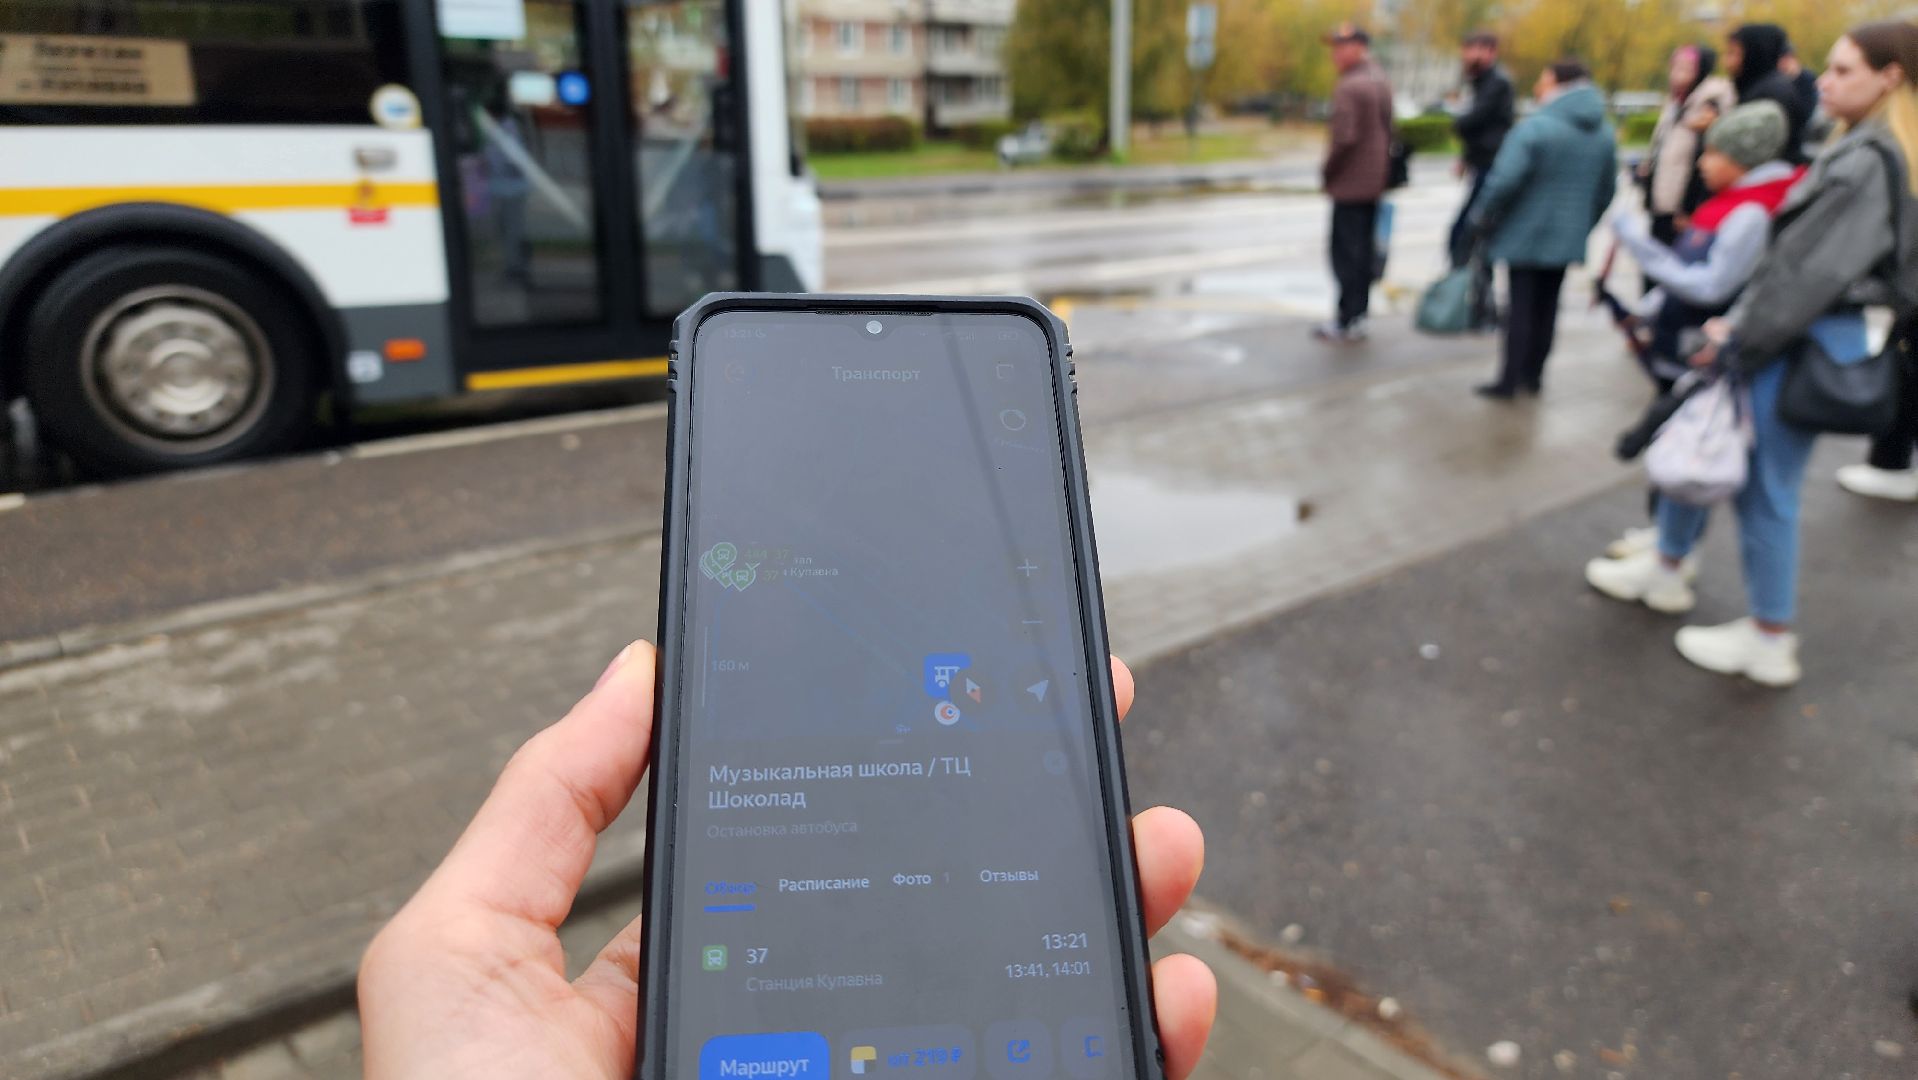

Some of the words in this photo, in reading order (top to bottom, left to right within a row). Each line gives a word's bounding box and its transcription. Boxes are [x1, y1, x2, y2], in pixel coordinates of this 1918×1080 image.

[831, 366, 921, 382] Транспорт
[708, 763, 853, 785] Музыкальная
[858, 760, 923, 778] школа
[928, 757, 937, 778] /
[942, 756, 972, 778] ТЦ
[707, 790, 806, 810] Шоколад
[706, 823, 787, 839] Остановка
[791, 820, 858, 836] автобуса
[778, 876, 870, 893] Расписание
[892, 870, 932, 887] Фото
[979, 868, 1040, 883] Отзывы
[1041, 932, 1088, 950] 13:21
[746, 947, 768, 965] 37
[1005, 963, 1050, 979] 13:41,
[1053, 960, 1091, 976] 14:01
[746, 975, 814, 992] Станция
[816, 972, 884, 990] Купавна
[719, 1056, 811, 1080] Маршрут
